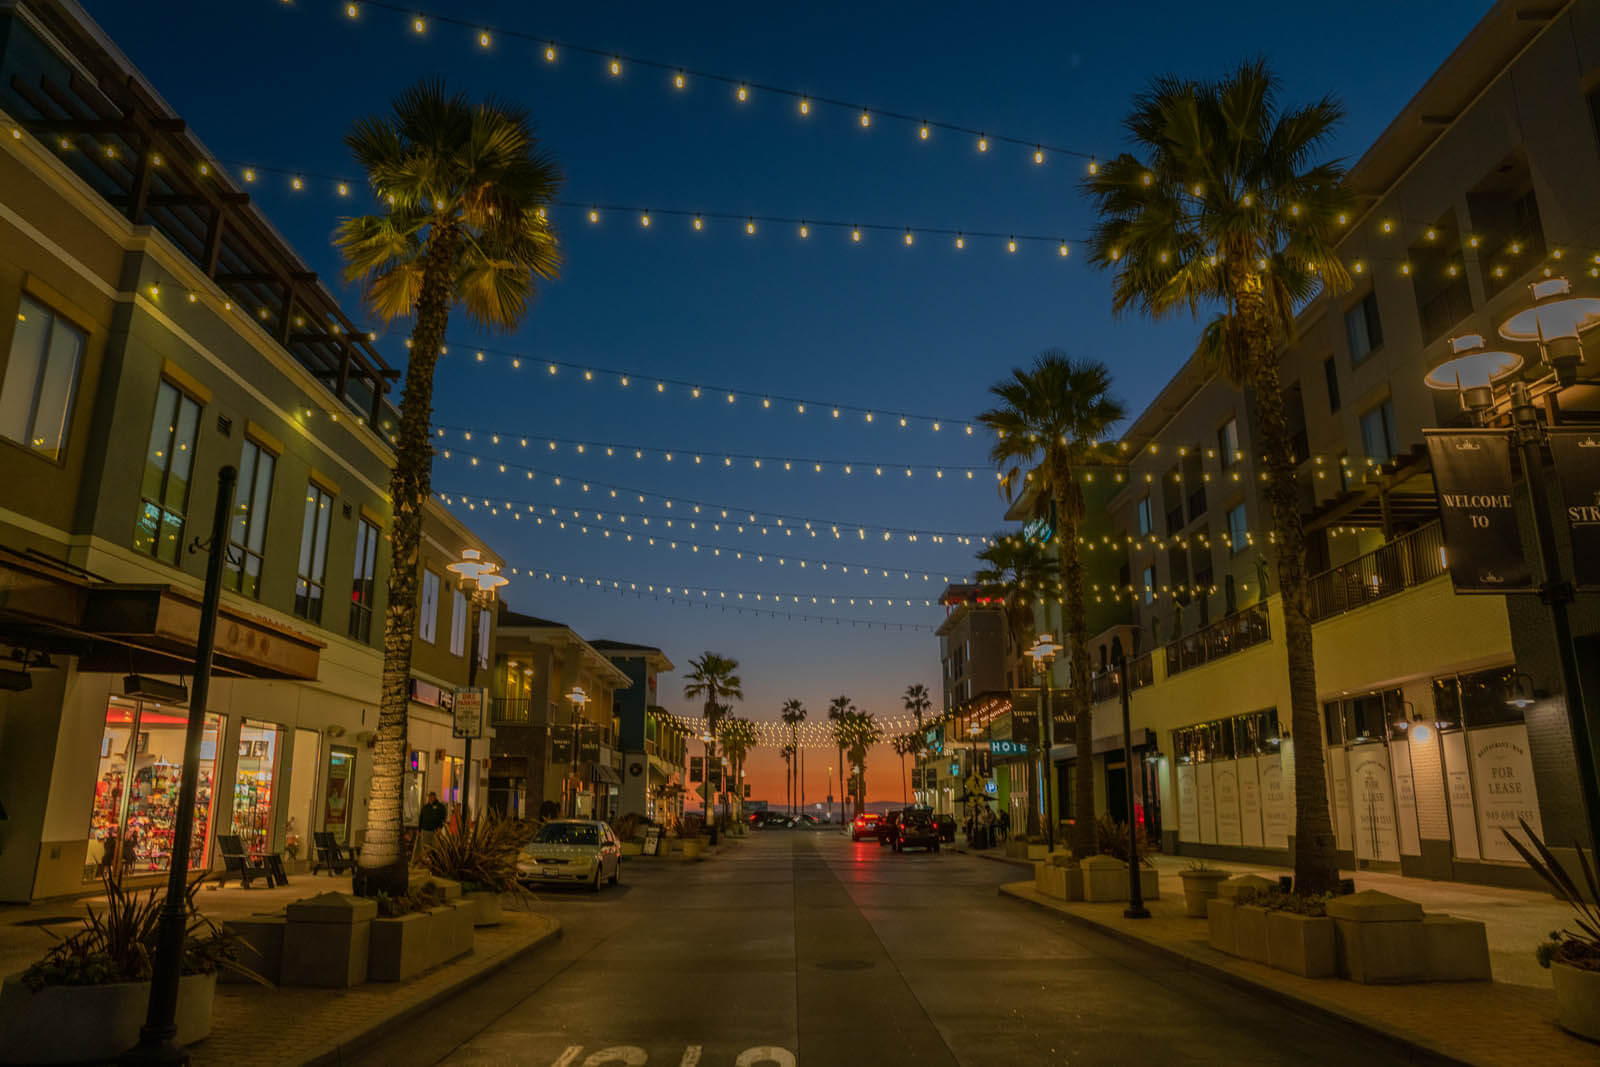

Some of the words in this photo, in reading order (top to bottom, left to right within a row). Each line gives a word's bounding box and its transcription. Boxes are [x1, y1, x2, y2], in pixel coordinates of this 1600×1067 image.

[1442, 494, 1512, 509] WELCOME
[1469, 514, 1489, 528] TO
[1491, 767, 1514, 779] FOR
[1488, 782, 1522, 794] LEASE
